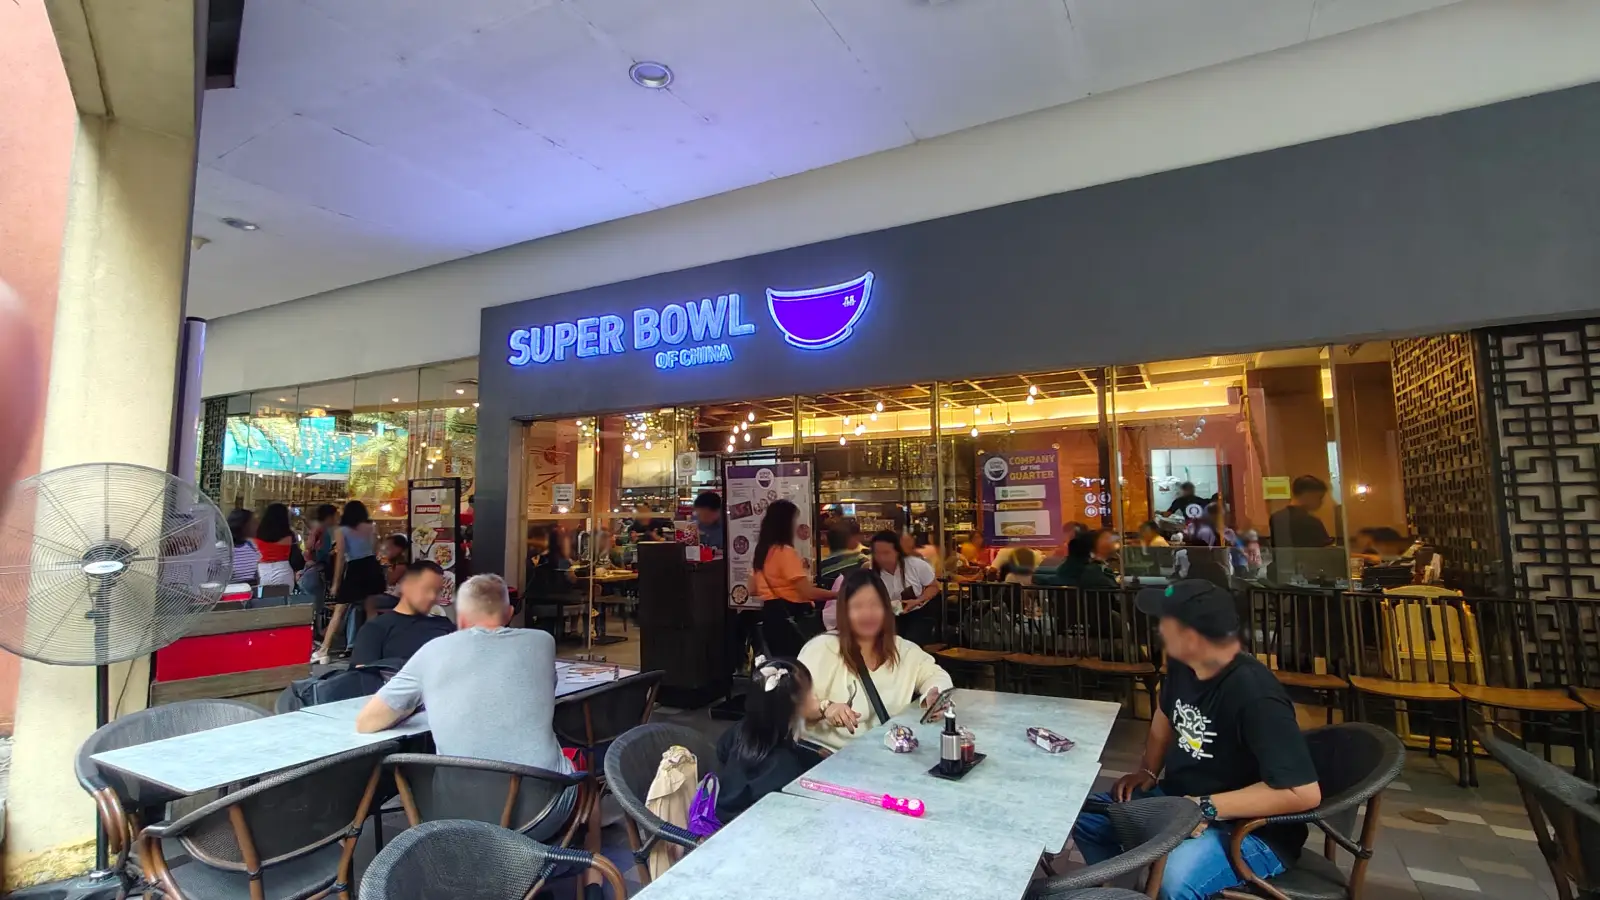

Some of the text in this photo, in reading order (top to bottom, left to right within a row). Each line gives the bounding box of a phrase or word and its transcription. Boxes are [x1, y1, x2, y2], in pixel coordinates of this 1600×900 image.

[508, 293, 755, 366] SUPER BOWL
[655, 343, 733, 369] OF CHINA
[1009, 454, 1056, 465] COMPANY
[1009, 470, 1055, 480] QUARTER
